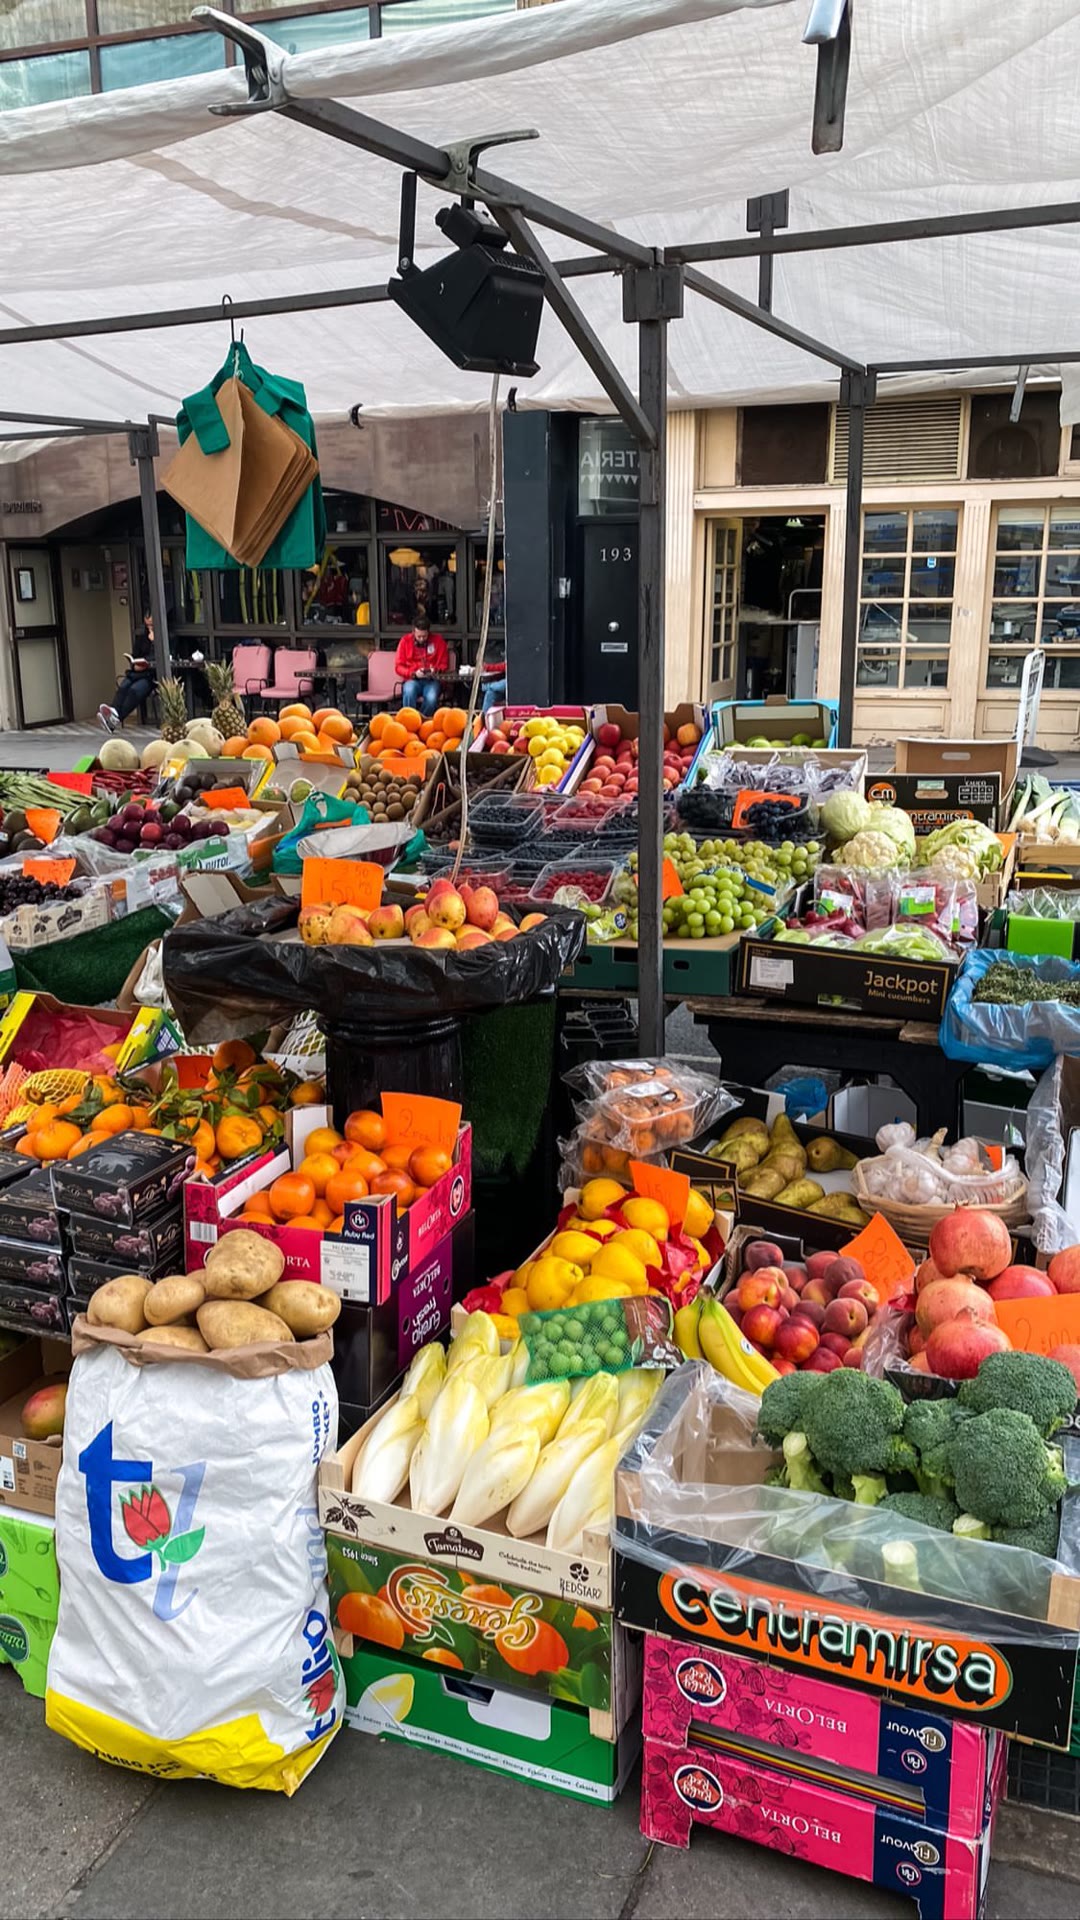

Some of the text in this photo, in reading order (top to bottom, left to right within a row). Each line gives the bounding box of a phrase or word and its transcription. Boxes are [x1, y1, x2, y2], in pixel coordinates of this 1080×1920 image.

[600, 547, 631, 561] 193
[864, 970, 939, 995] Jackpot
[868, 988, 931, 1004] Mini cucumbers
[344, 1230, 375, 1240] Ruby Red
[311, 1400, 321, 1465] JUMBO
[342, 1546, 378, 1567] Since 1953
[427, 1538, 481, 1559] Tomatoes
[672, 1576, 997, 1697] centramirsa
[684, 1672, 715, 1697] Ruby
[689, 1666, 712, 1685] Red
[765, 1698, 847, 1734] BELORTA
[886, 1721, 938, 1746] Flavour
[681, 1780, 713, 1802] Ruby
[687, 1773, 710, 1790] Red
[760, 1806, 842, 1844] BELORTA
[880, 1834, 932, 1860] Flavour
